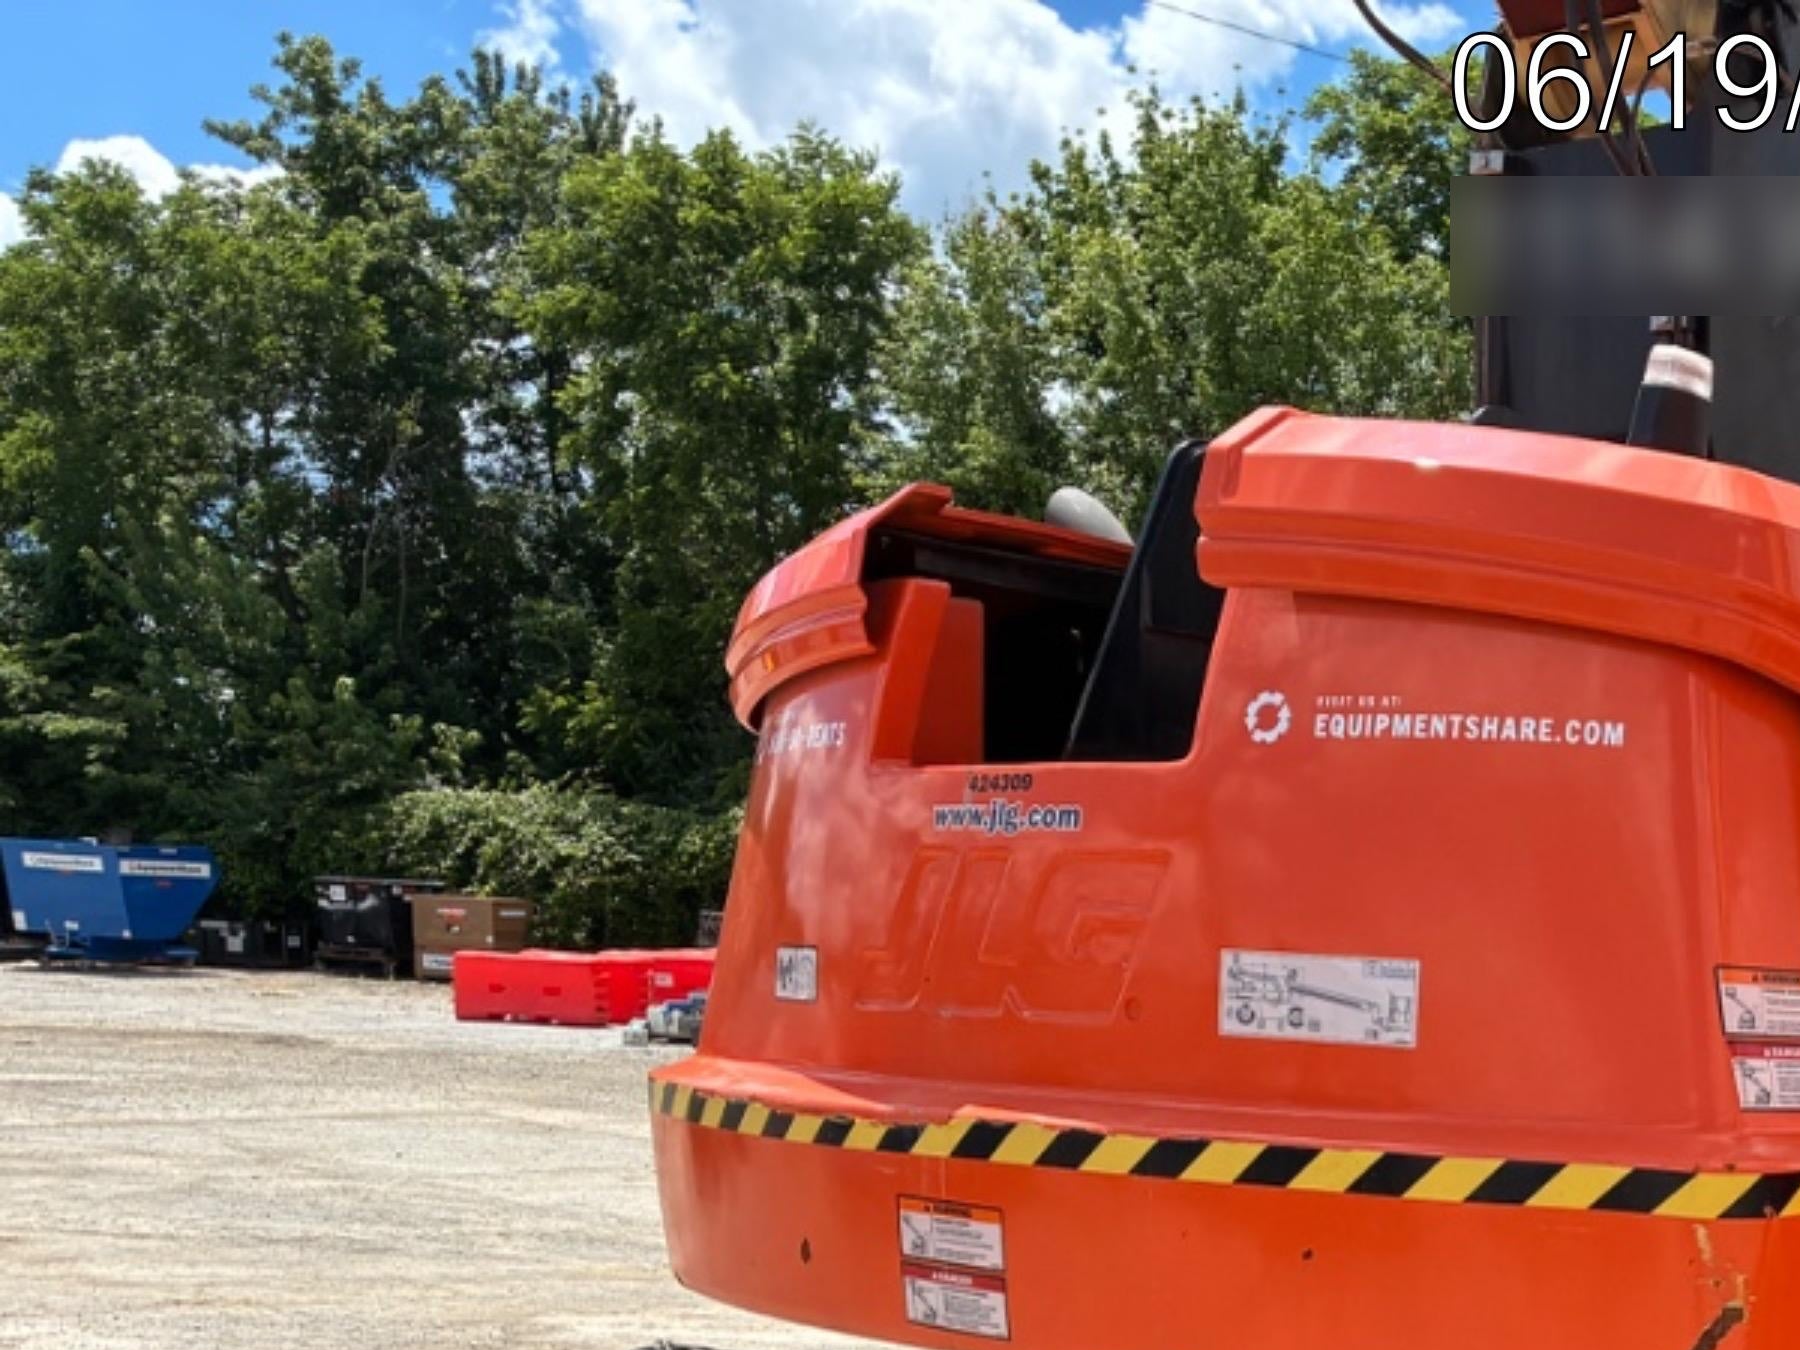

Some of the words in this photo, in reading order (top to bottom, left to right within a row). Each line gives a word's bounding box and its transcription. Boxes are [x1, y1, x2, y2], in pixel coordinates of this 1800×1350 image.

[1313, 712, 1625, 747] EQUIPMENTSHARE.COM
[933, 798, 1083, 836] www.jlg.com
[853, 846, 1171, 1024] JLG
